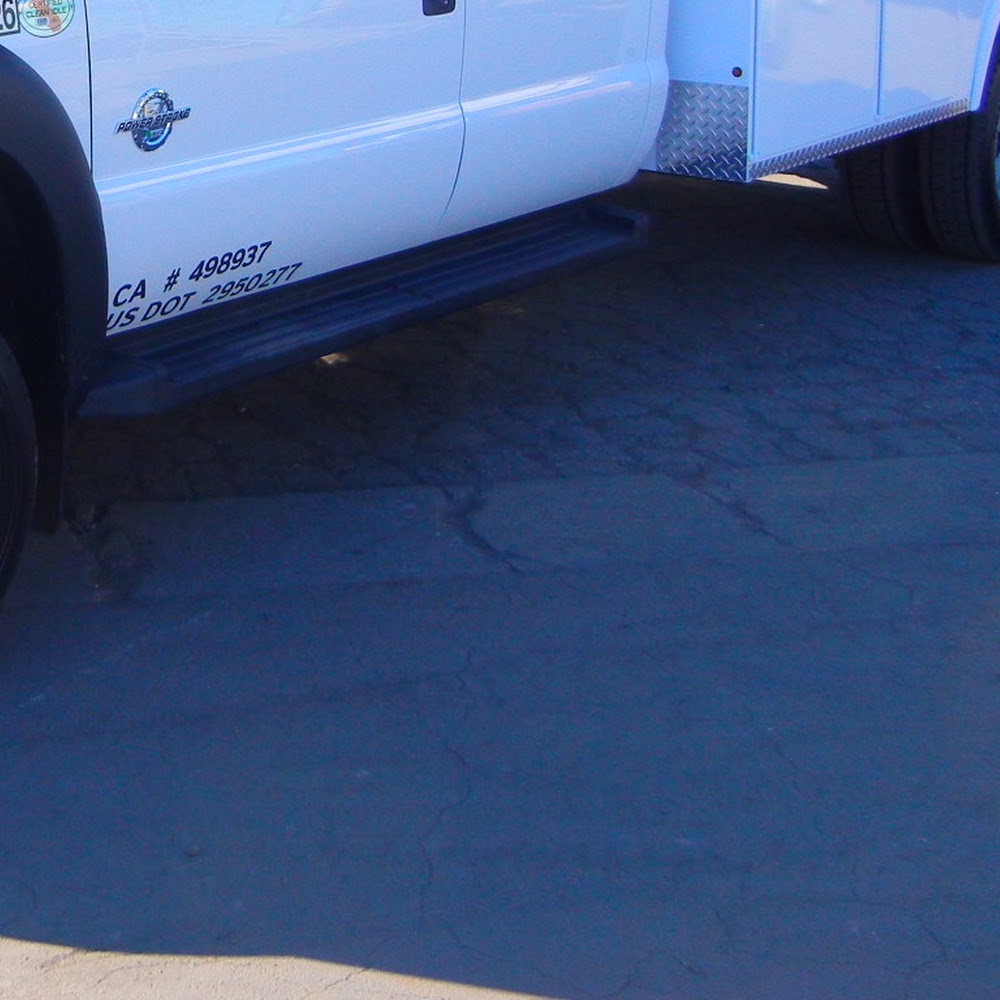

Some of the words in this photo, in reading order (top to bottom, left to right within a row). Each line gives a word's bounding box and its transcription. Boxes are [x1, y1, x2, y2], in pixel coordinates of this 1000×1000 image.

[26, 9, 50, 18] CLEAN
[115, 117, 153, 134] POWER
[154, 107, 191, 126] STROKE
[105, 307, 140, 331] US
[141, 291, 197, 322] DOT
[202, 262, 303, 304] 2950277
[113, 279, 147, 307] CA
[163, 267, 182, 293] #
[189, 240, 273, 282] 498937
